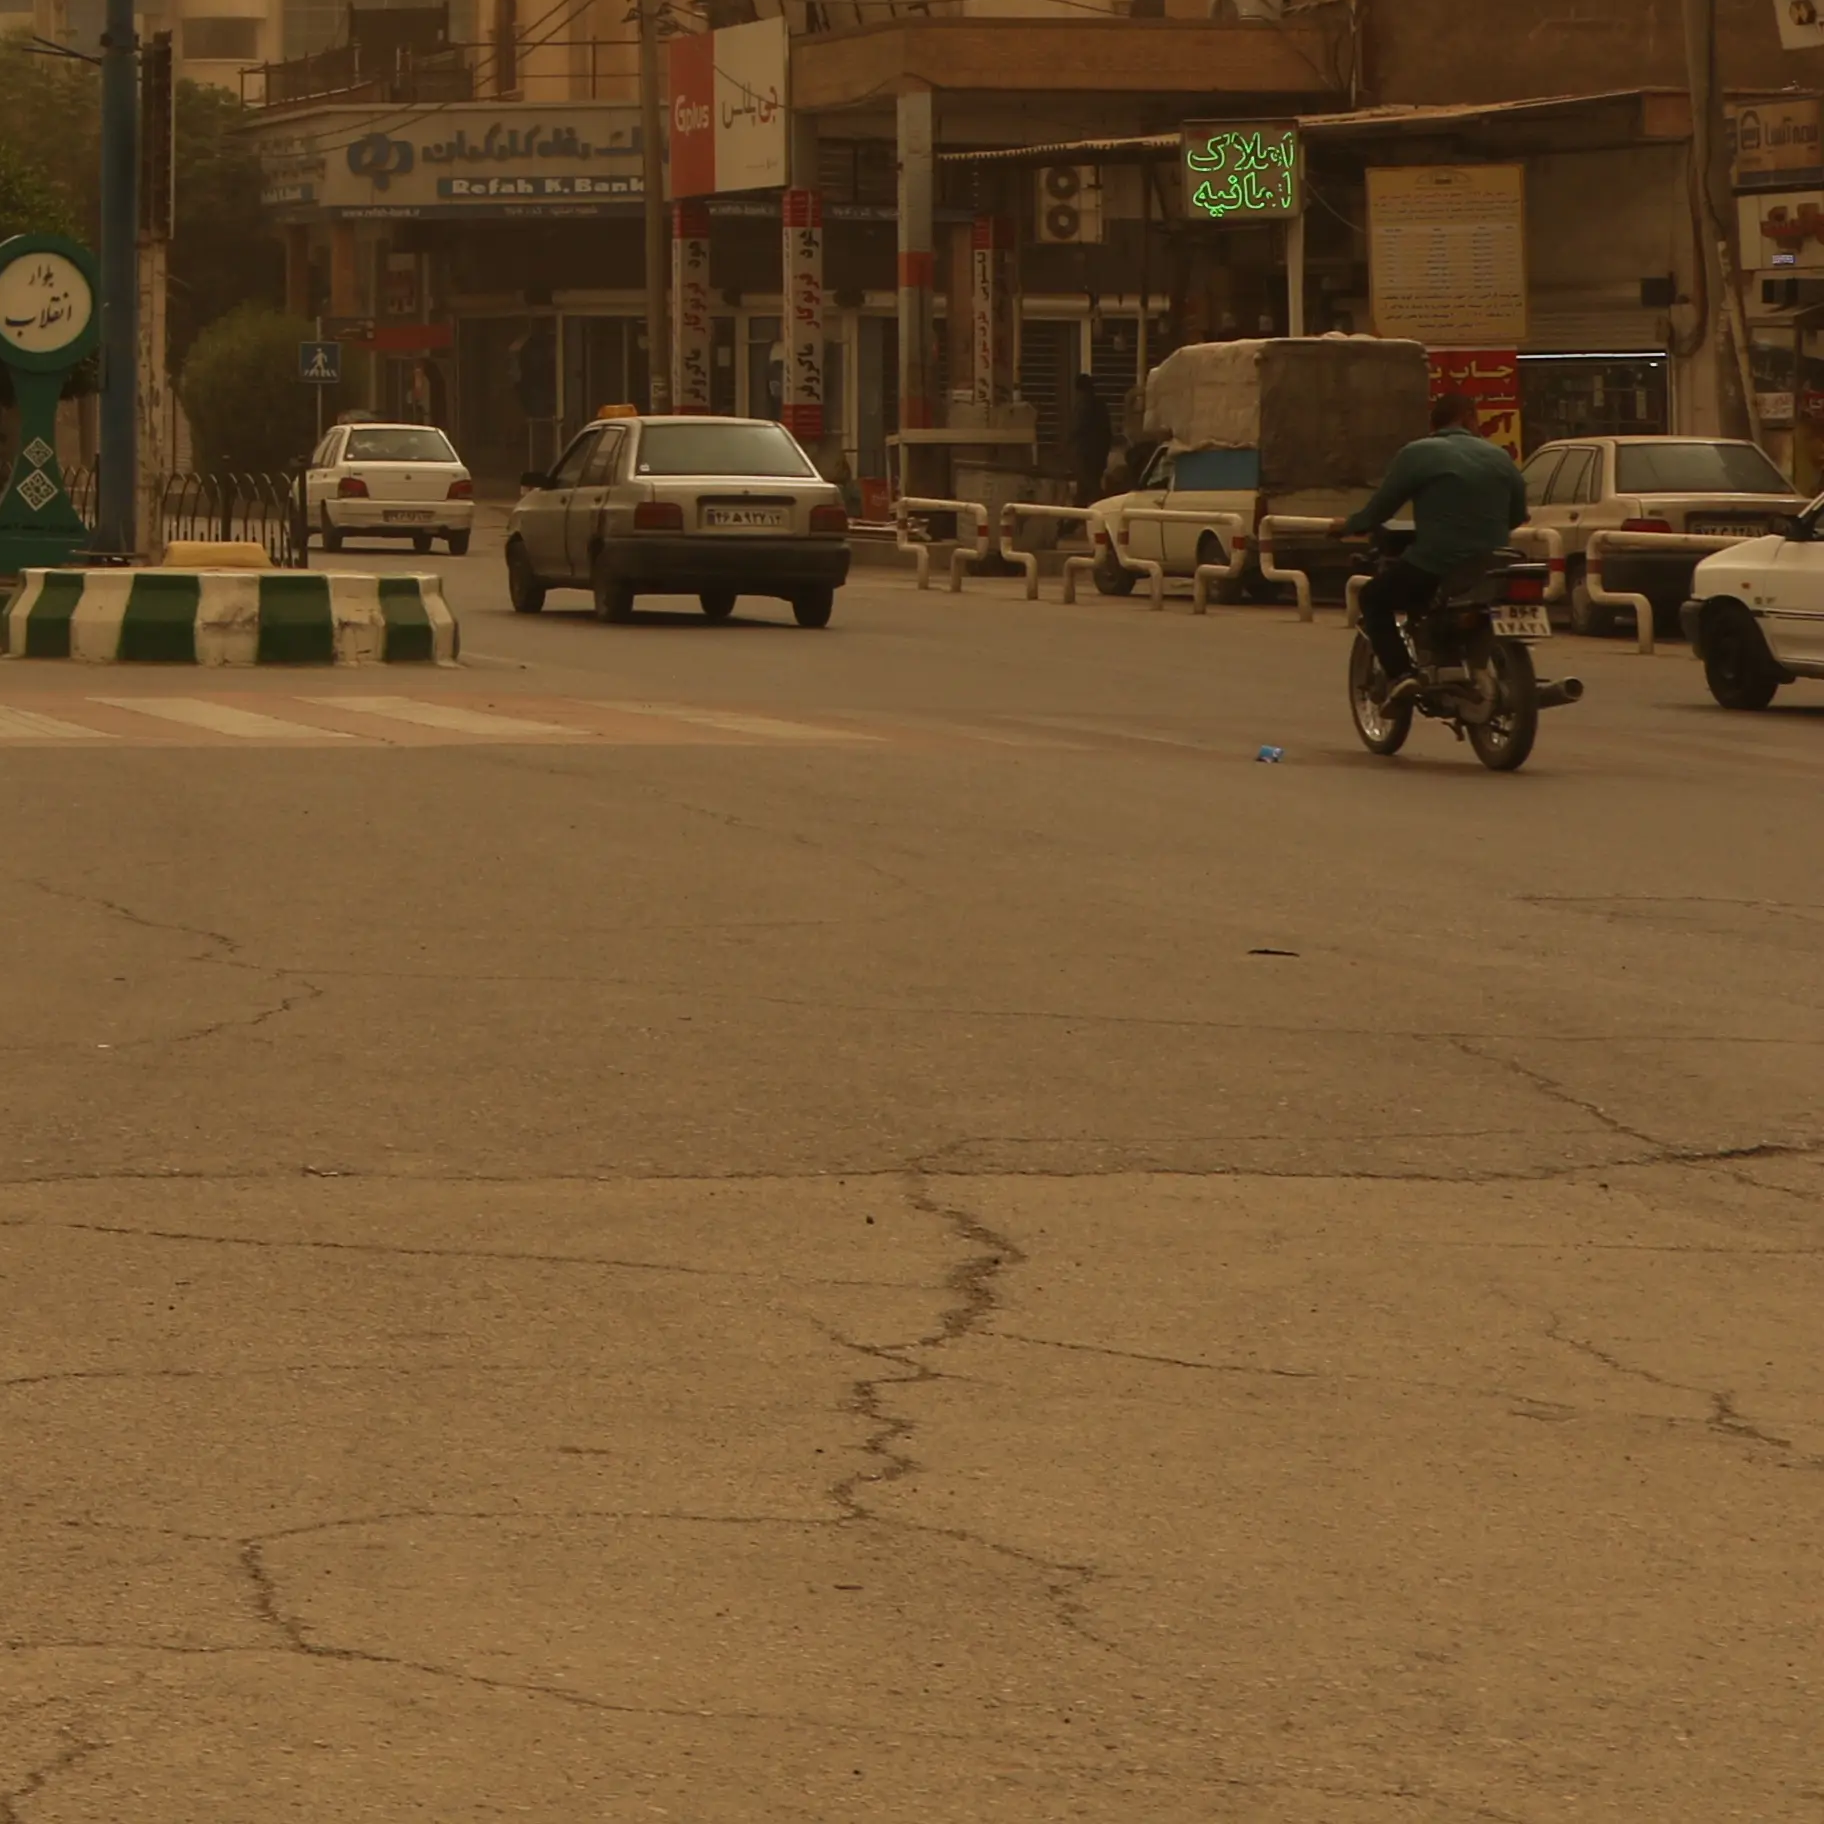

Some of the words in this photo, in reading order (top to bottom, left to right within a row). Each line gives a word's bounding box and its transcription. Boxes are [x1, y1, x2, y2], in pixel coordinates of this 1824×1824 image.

[674, 94, 710, 137] Gplus
[452, 178, 535, 195] Refah
[5, 292, 72, 336] انقلاب
